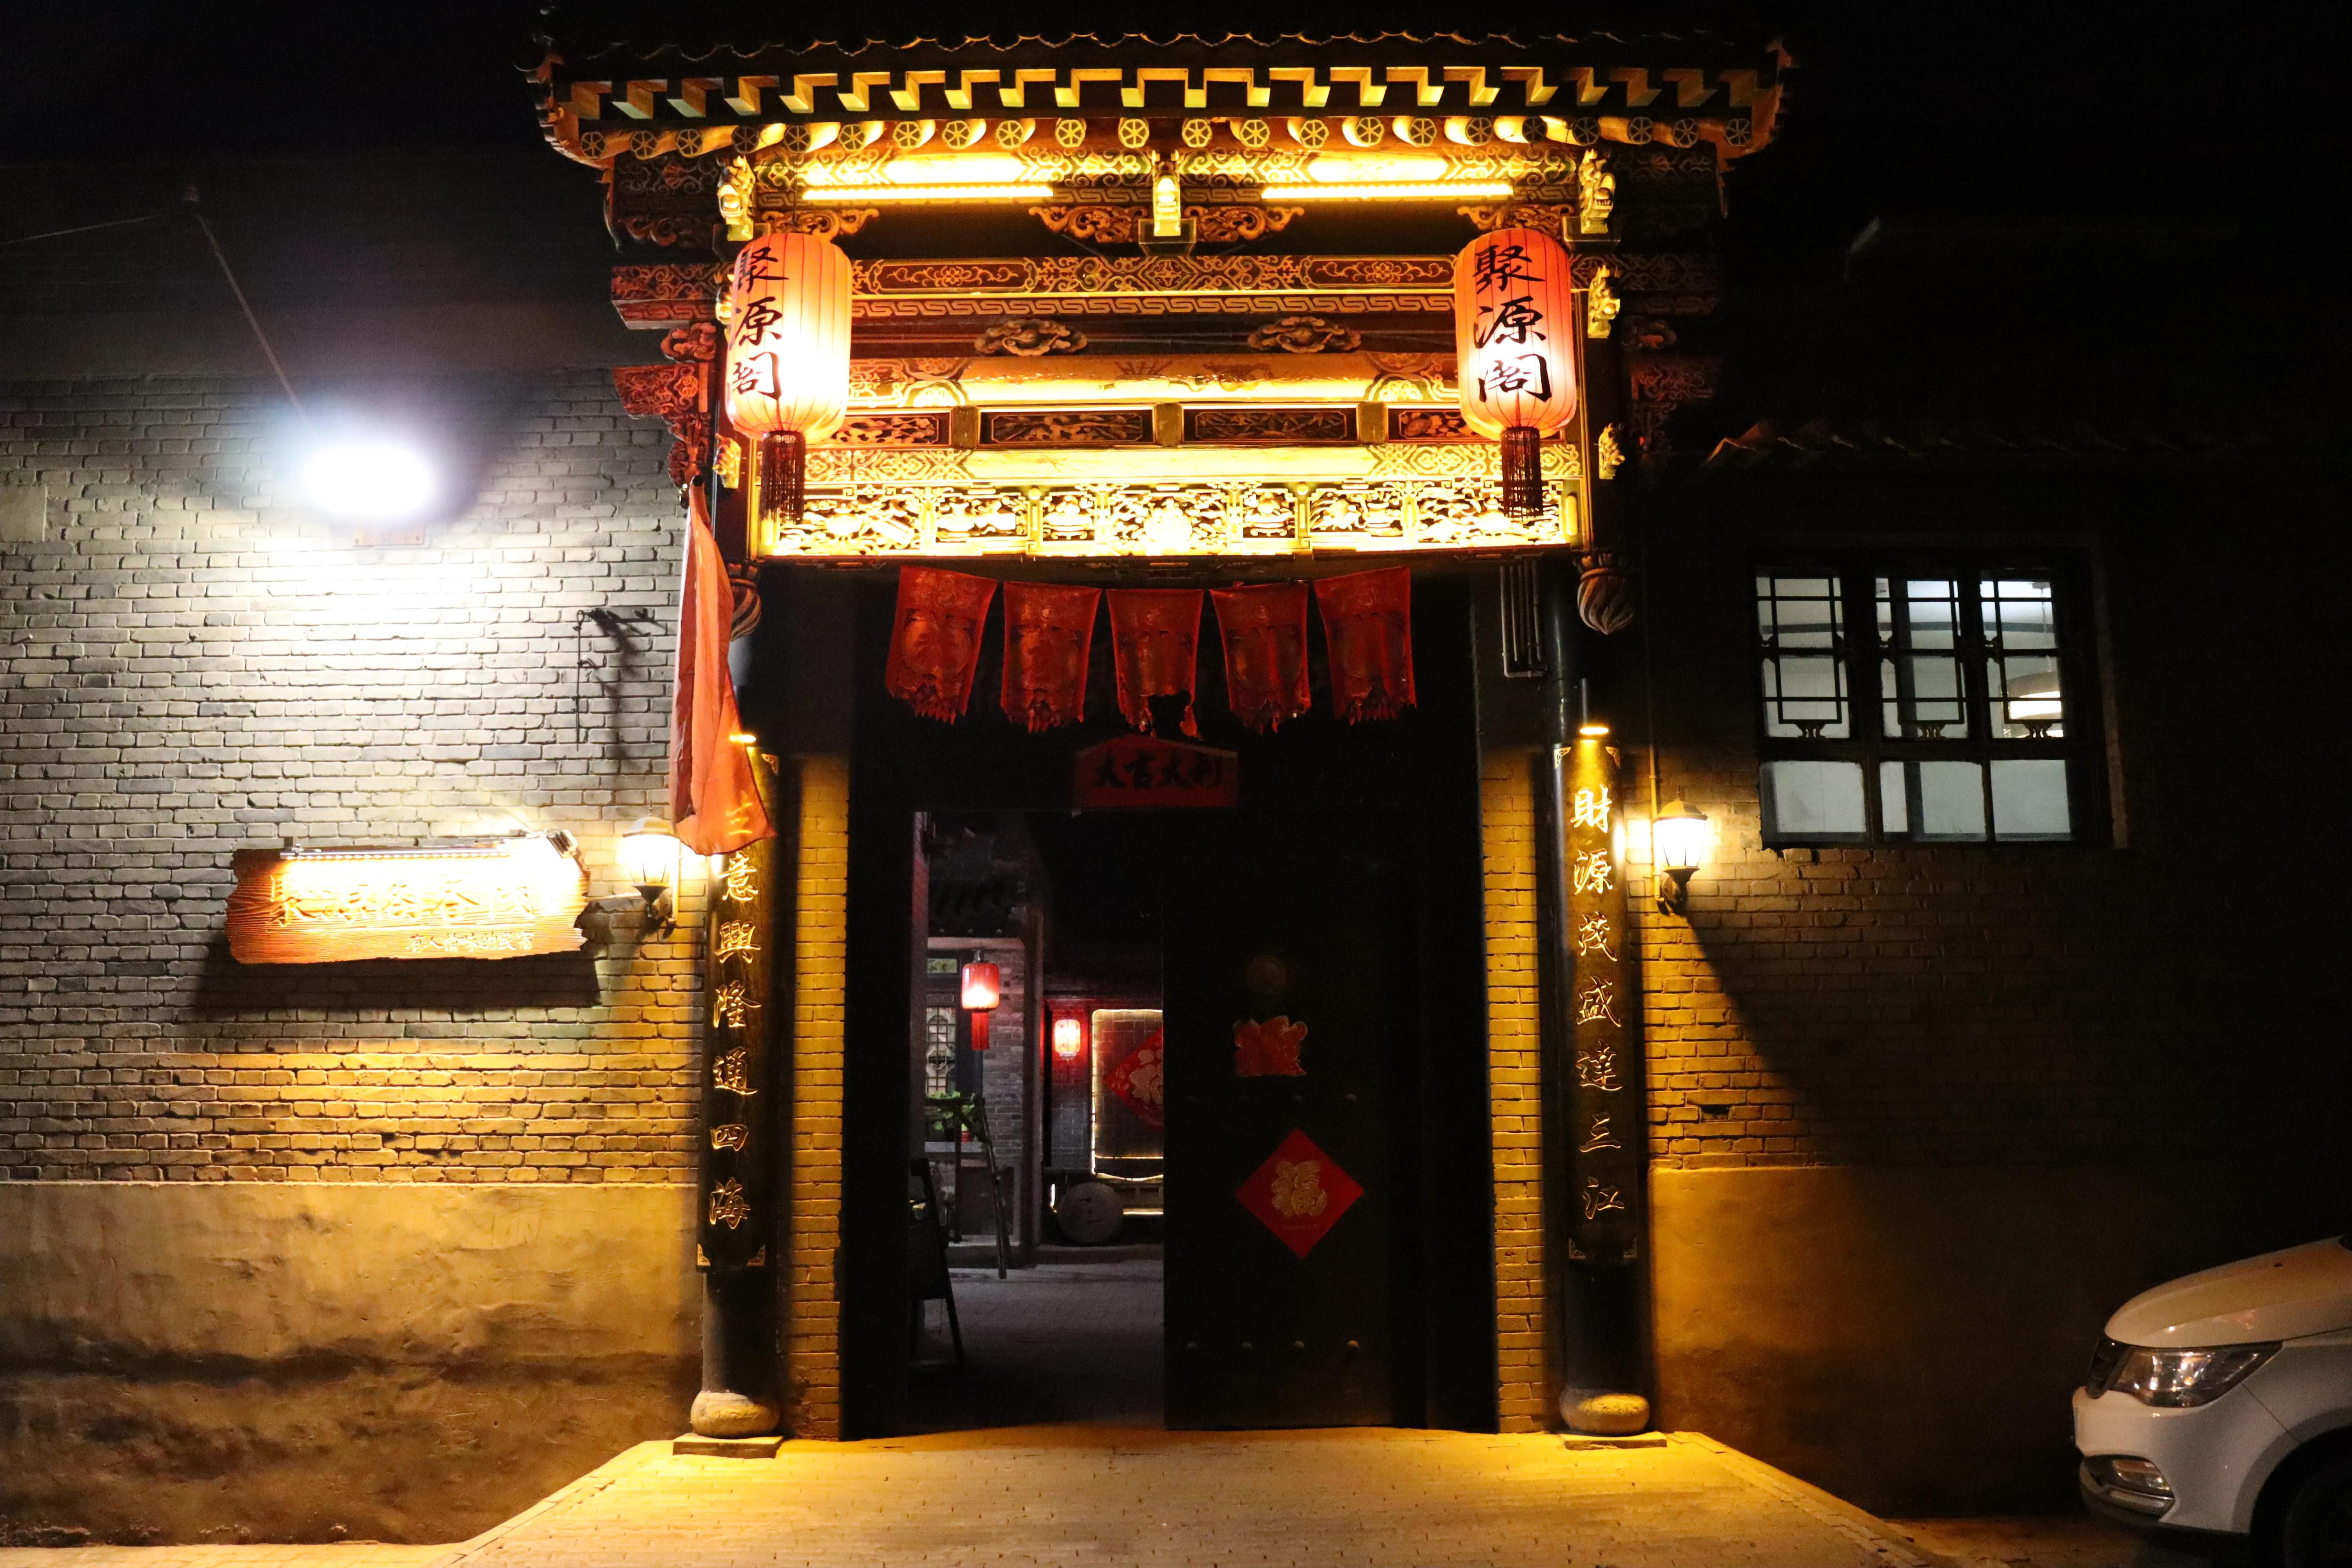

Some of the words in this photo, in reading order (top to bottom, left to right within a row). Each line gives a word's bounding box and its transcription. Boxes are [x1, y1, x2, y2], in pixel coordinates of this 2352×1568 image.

[406, 931, 535, 954] 有人情味的民宿
